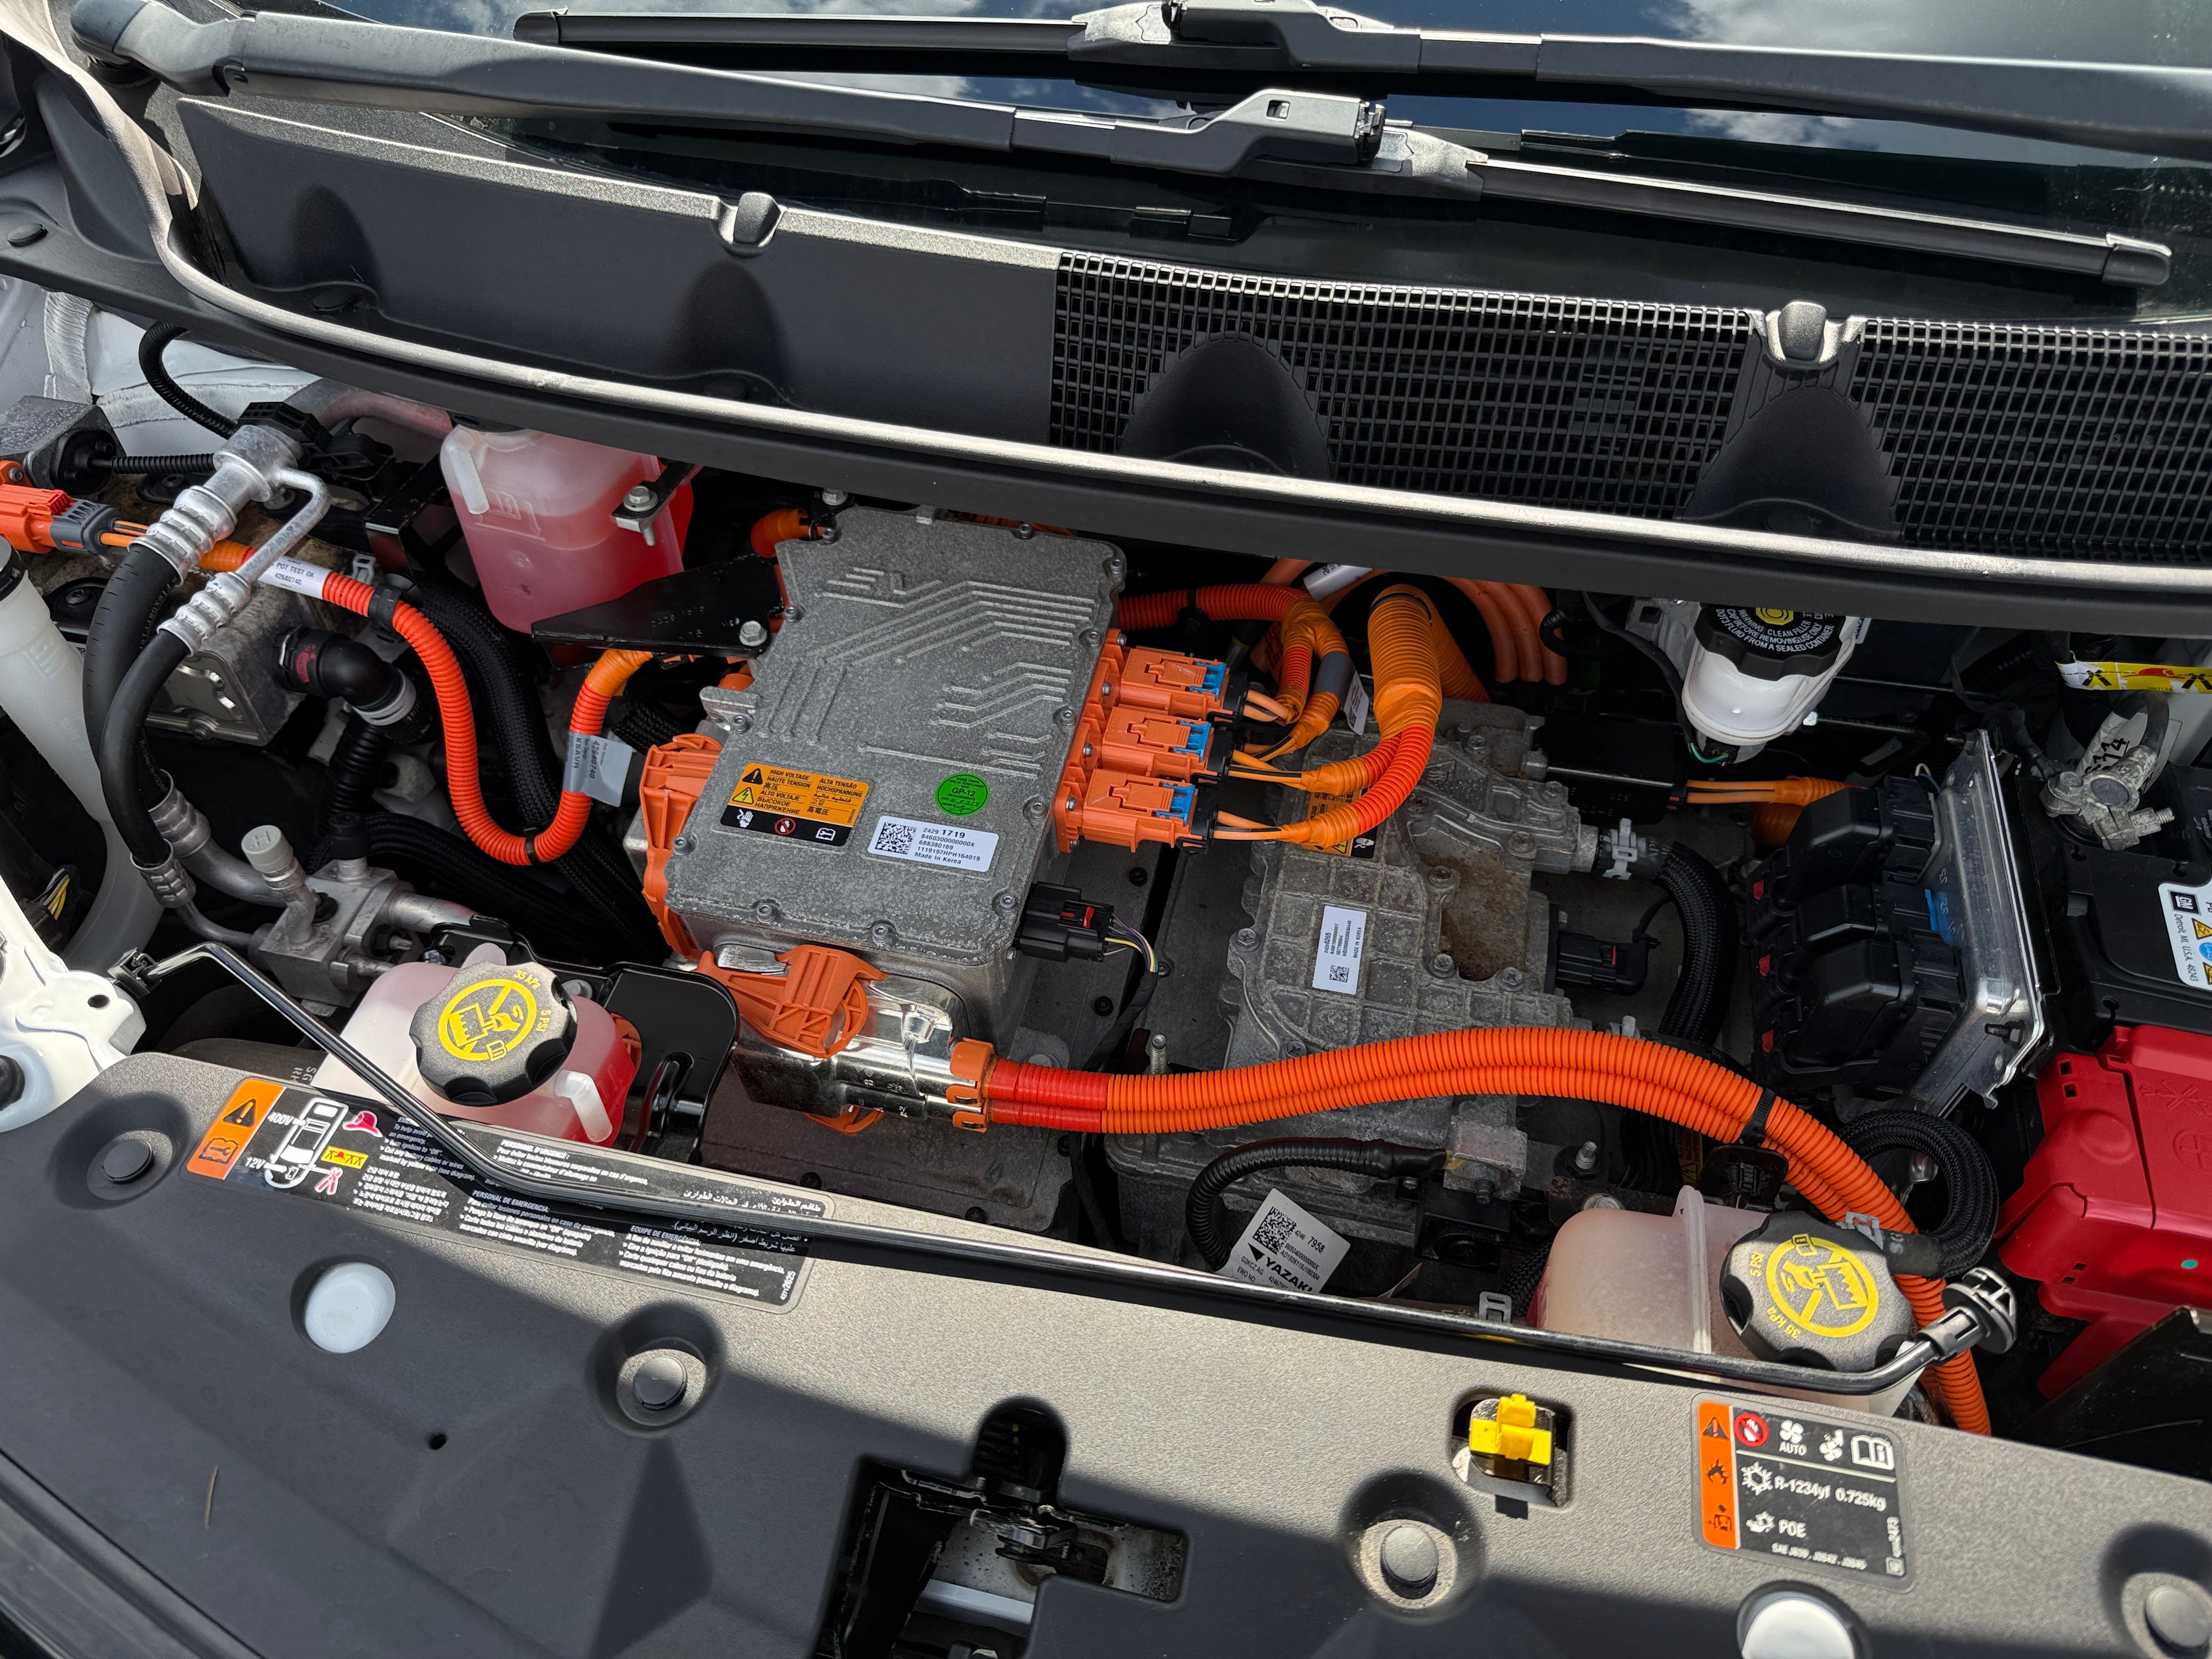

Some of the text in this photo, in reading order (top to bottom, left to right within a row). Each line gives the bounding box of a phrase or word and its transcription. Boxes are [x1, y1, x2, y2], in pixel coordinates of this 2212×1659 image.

[291, 566, 306, 575] TEST
[1726, 608, 1736, 621] CAP
[1734, 618, 1760, 638] BEFORE
[1810, 622, 1822, 637] ONLY
[1768, 629, 1793, 637] CLEAN
[1792, 620, 1812, 635] FILLER
[1725, 622, 1745, 638] FLUID
[1743, 636, 1767, 648] FROM
[1776, 643, 1807, 652] SEALED
[1805, 625, 1834, 649] CONTAINER
[766, 775, 811, 789] HAUTE TENSION
[785, 771, 810, 781] VOLTAGE
[819, 777, 857, 789] ALTA TENSÃO
[776, 792, 800, 801] VOLTAJE
[816, 783, 862, 798] HOCHSPANNUNG
[952, 787, 975, 797] GP-12
[754, 802, 800, 815] НАПРЯЖЕНИЕ
[757, 796, 791, 807] ВЫСОКОЕ
[942, 830, 965, 838] 1719
[2176, 896, 2193, 910] GM
[514, 970, 526, 980] 35
[535, 1017, 550, 1032] PSI
[268, 1111, 294, 1126] 400V
[400, 1124, 412, 1134] help
[396, 1132, 425, 1145] emergency,
[401, 1141, 421, 1153] ignition
[496, 1145, 511, 1156] Pour
[500, 1139, 533, 1153] PERSONNEL
[245, 1156, 265, 1170] 12V
[385, 1145, 395, 1154] Cut
[394, 1148, 406, 1158] any
[424, 1155, 442, 1165] cables
[449, 1160, 464, 1170] wires
[380, 1153, 400, 1164] marked
[400, 1158, 408, 1167] by
[407, 1159, 426, 1171] yellow
[438, 1167, 450, 1176] (see
[450, 1169, 475, 1182] diagram).
[472, 1189, 550, 1214] PERSONAL DE EMERGENCIA:
[467, 1197, 482, 1207] Para
[498, 1204, 520, 1216] lesiones
[520, 1209, 550, 1224] personales
[560, 1219, 572, 1227] caso
[573, 1221, 580, 1229] de
[460, 1222, 487, 1235] marcados
[487, 1229, 498, 1238] con
[631, 1224, 651, 1236] EQUIPE
[652, 1229, 662, 1238] DE
[1295, 1230, 1325, 1253] 4246 7958
[619, 1259, 648, 1272] marcados
[1257, 1267, 1264, 1276] AG
[1750, 1251, 1765, 1278] 5 PSI
[1237, 1266, 1248, 1277] EWO
[1246, 1273, 1256, 1283] NO
[1784, 1325, 1801, 1339] 35
[1779, 1441, 1807, 1456] AUTO
[1774, 1476, 1887, 1512] R-1234yf 0.725kg
[1779, 1519, 1808, 1538] POE
